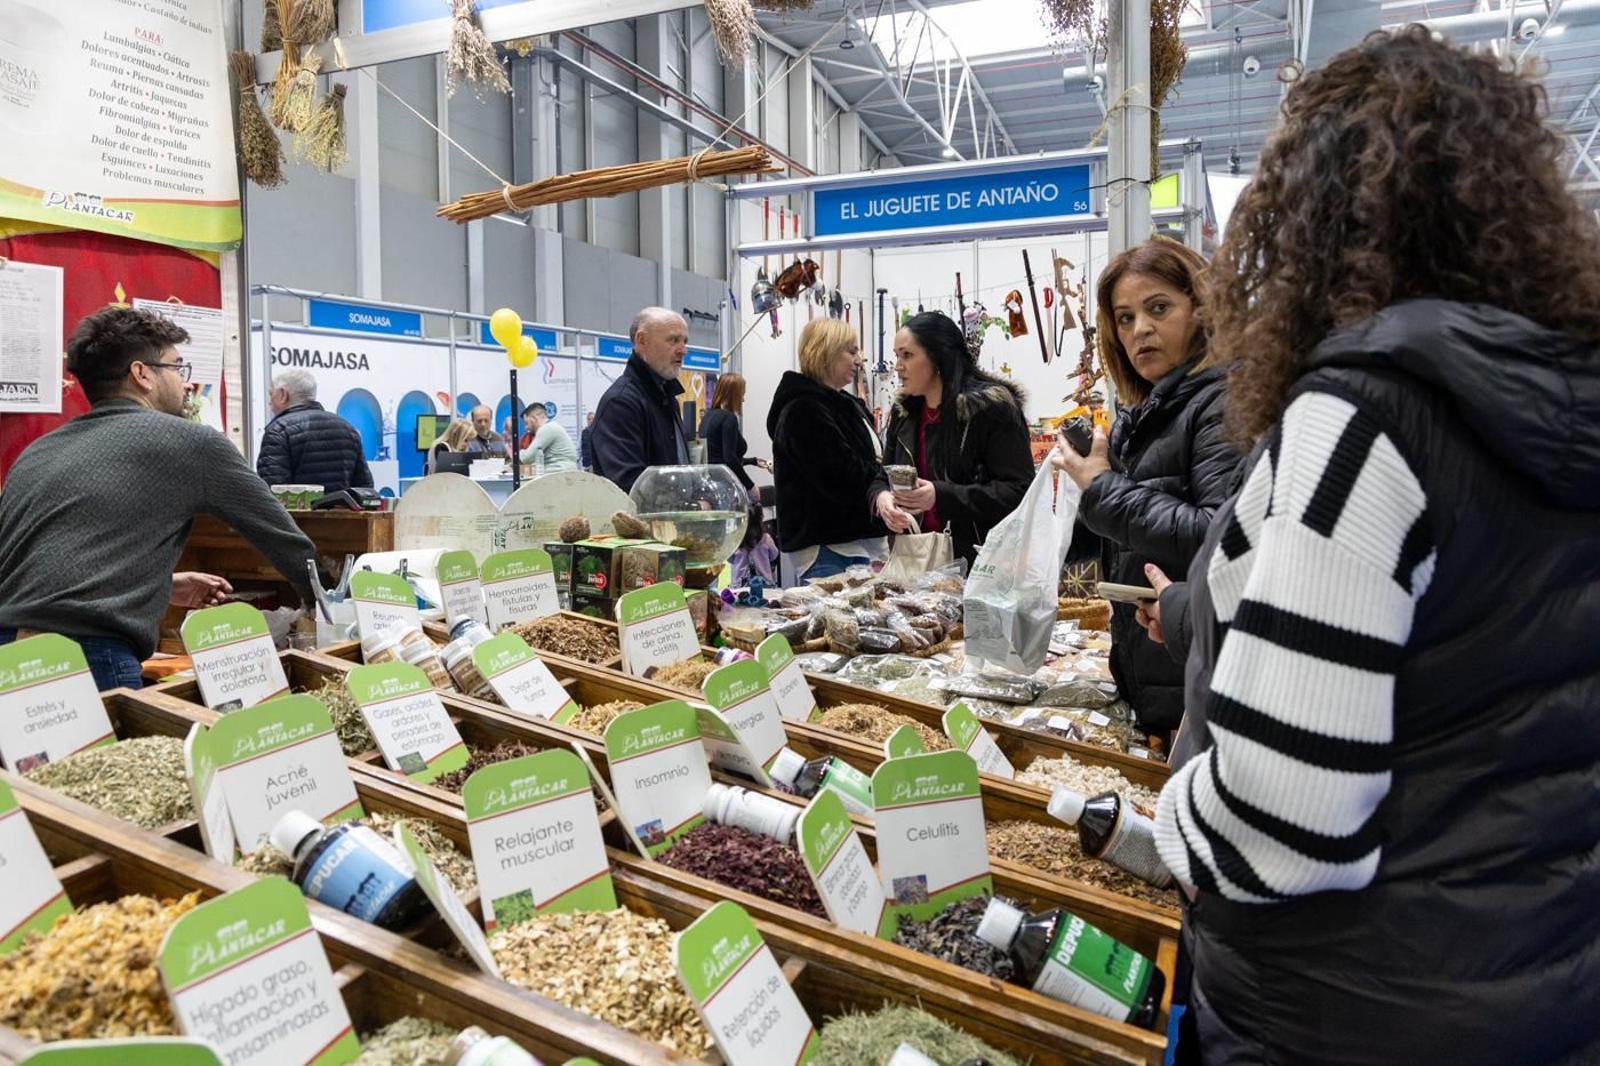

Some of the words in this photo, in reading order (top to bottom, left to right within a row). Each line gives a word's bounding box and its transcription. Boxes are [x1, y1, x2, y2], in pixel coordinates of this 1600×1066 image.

[144, 2, 178, 21] Castaño
[180, 15, 188, 25] de
[189, 20, 213, 34] indias
[134, 26, 165, 45] PARA:
[81, 39, 119, 60] Dolores
[121, 53, 170, 76] acentuados
[175, 71, 211, 88] Artrosis
[103, 31, 156, 56] Lumbalgias
[163, 52, 190, 69] Ciática
[90, 57, 124, 76] Reuma
[132, 70, 163, 88] Piernas
[165, 83, 204, 100] cansadas
[111, 79, 143, 97] Artritis
[150, 90, 188, 110] Jaquecas
[88, 88, 117, 104] Dolor
[118, 96, 128, 107] de
[130, 101, 160, 116] cabeza
[167, 110, 209, 129] Migrañas
[99, 106, 161, 130] Fibromialgias
[169, 124, 201, 140] Varices
[91, 134, 118, 149] Dolor
[119, 139, 130, 152] de
[132, 144, 159, 159] cuello
[167, 152, 212, 169] Tendinitis
[115, 125, 140, 140] Dolor
[141, 132, 152, 144] de
[153, 135, 188, 151] espalda
[101, 152, 147, 172] Esguinces
[155, 164, 204, 181] Luxaciones
[103, 167, 152, 186] Problemas
[153, 177, 205, 195] musculares
[45, 192, 134, 222] PLANTACAR
[841, 202, 859, 220] EL
[864, 193, 940, 218] JUGUETE
[946, 191, 972, 210] DE
[977, 180, 1059, 207] ANTAÑO
[1073, 201, 1088, 211] 56
[348, 312, 392, 328] SOMAJASA
[508, 602, 537, 614] fisuras
[532, 593, 541, 603] y
[198, 626, 253, 646] PLANTACAR
[632, 619, 686, 641] Infecciones
[642, 637, 655, 650] de
[657, 631, 683, 644] orina,
[197, 645, 269, 672] Menstruación
[652, 643, 679, 657] cistitis
[211, 664, 256, 683] irregular
[256, 661, 265, 674] y
[220, 674, 267, 693] dolorosa
[510, 678, 532, 695] Dejar
[533, 674, 542, 686] de
[368, 681, 421, 700] PLANTACAR
[524, 688, 546, 703] fumar
[24, 709, 78, 733] ansiedad
[25, 702, 57, 718] Estrés
[57, 700, 65, 712] y
[391, 714, 423, 727] ardores
[424, 712, 431, 724] y
[232, 723, 315, 758] PLANTACAR
[391, 725, 430, 742] pesadez
[431, 721, 442, 733] de
[401, 733, 445, 750] estómago
[622, 728, 684, 753] PLANTACAR
[634, 763, 690, 790] Insomnio
[264, 779, 317, 810] juvenil
[484, 779, 569, 811] PLANTACAR
[891, 781, 965, 801] PLANTACAR
[493, 818, 574, 853] Relajante
[906, 822, 960, 843] Celulitis
[500, 836, 576, 870] muscular
[186, 919, 287, 976] PLANTACAR
[189, 979, 260, 1029] Hígado
[207, 986, 308, 1042] nflamación
[309, 977, 319, 999] y
[721, 989, 769, 1043] Retención
[768, 974, 782, 994] de
[745, 1005, 783, 1048] líquidos
